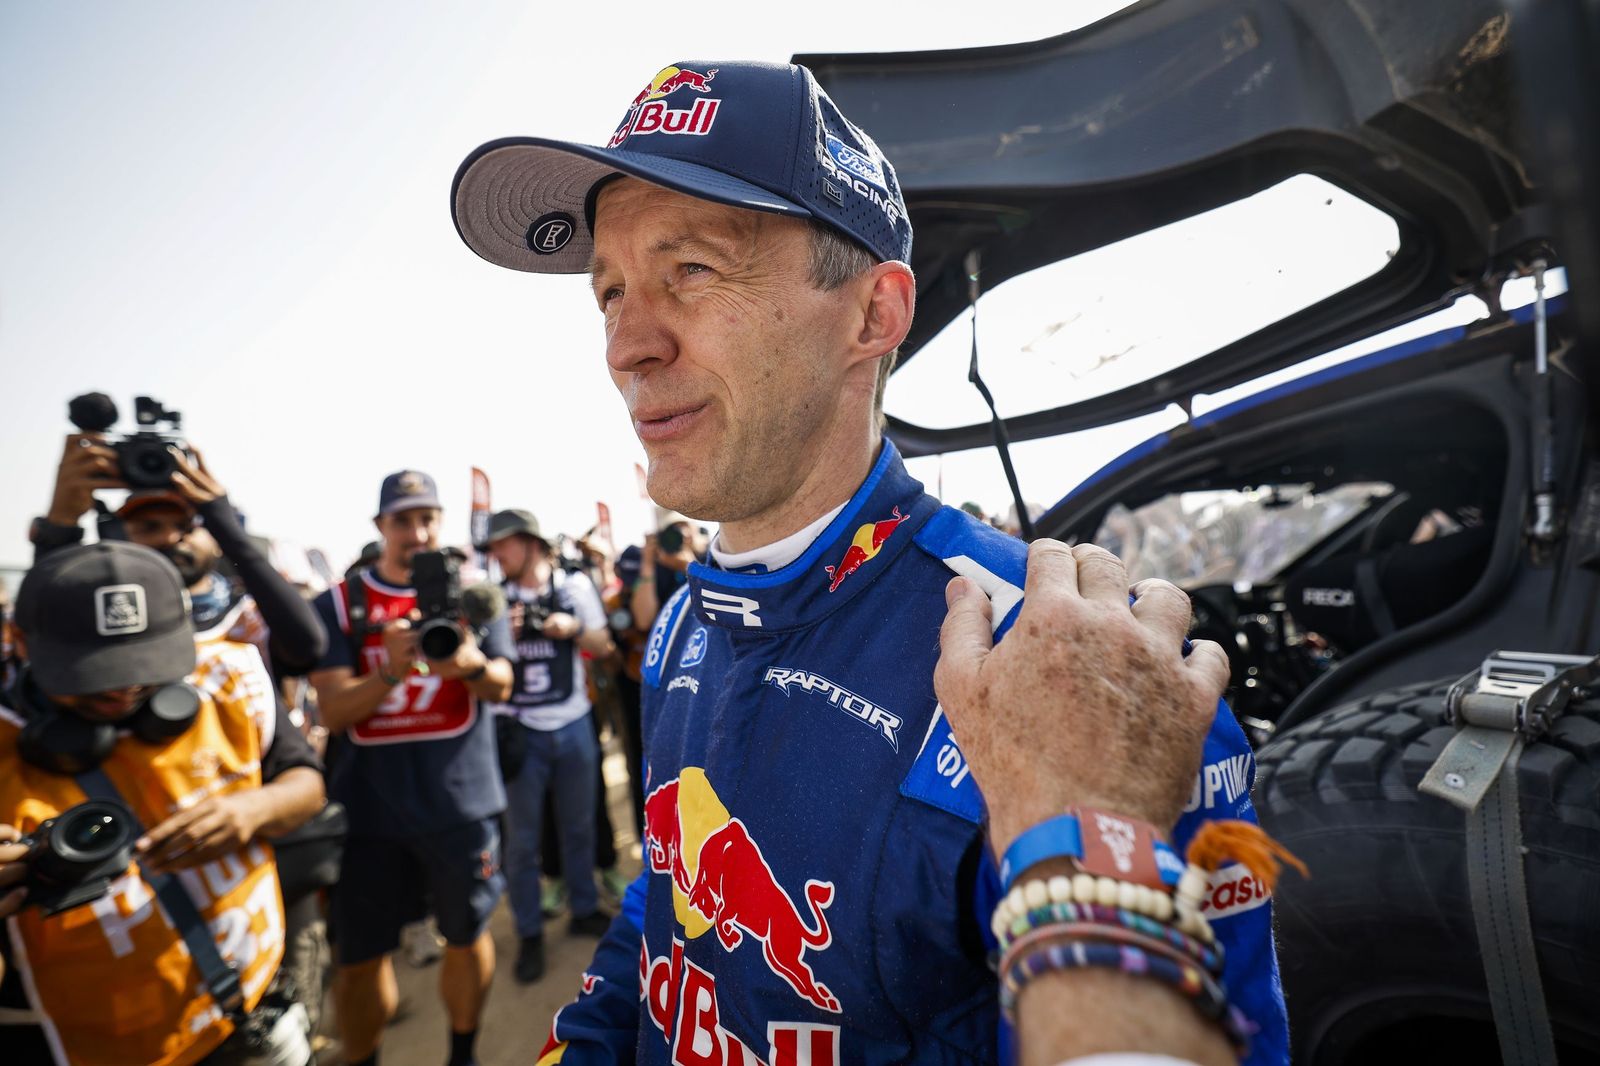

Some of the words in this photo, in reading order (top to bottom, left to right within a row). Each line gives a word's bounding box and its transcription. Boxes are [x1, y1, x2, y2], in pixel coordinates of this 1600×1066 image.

[631, 99, 721, 136] Bull
[837, 147, 883, 182] Ford
[523, 662, 552, 693] 5
[764, 666, 903, 754] RAPTOR
